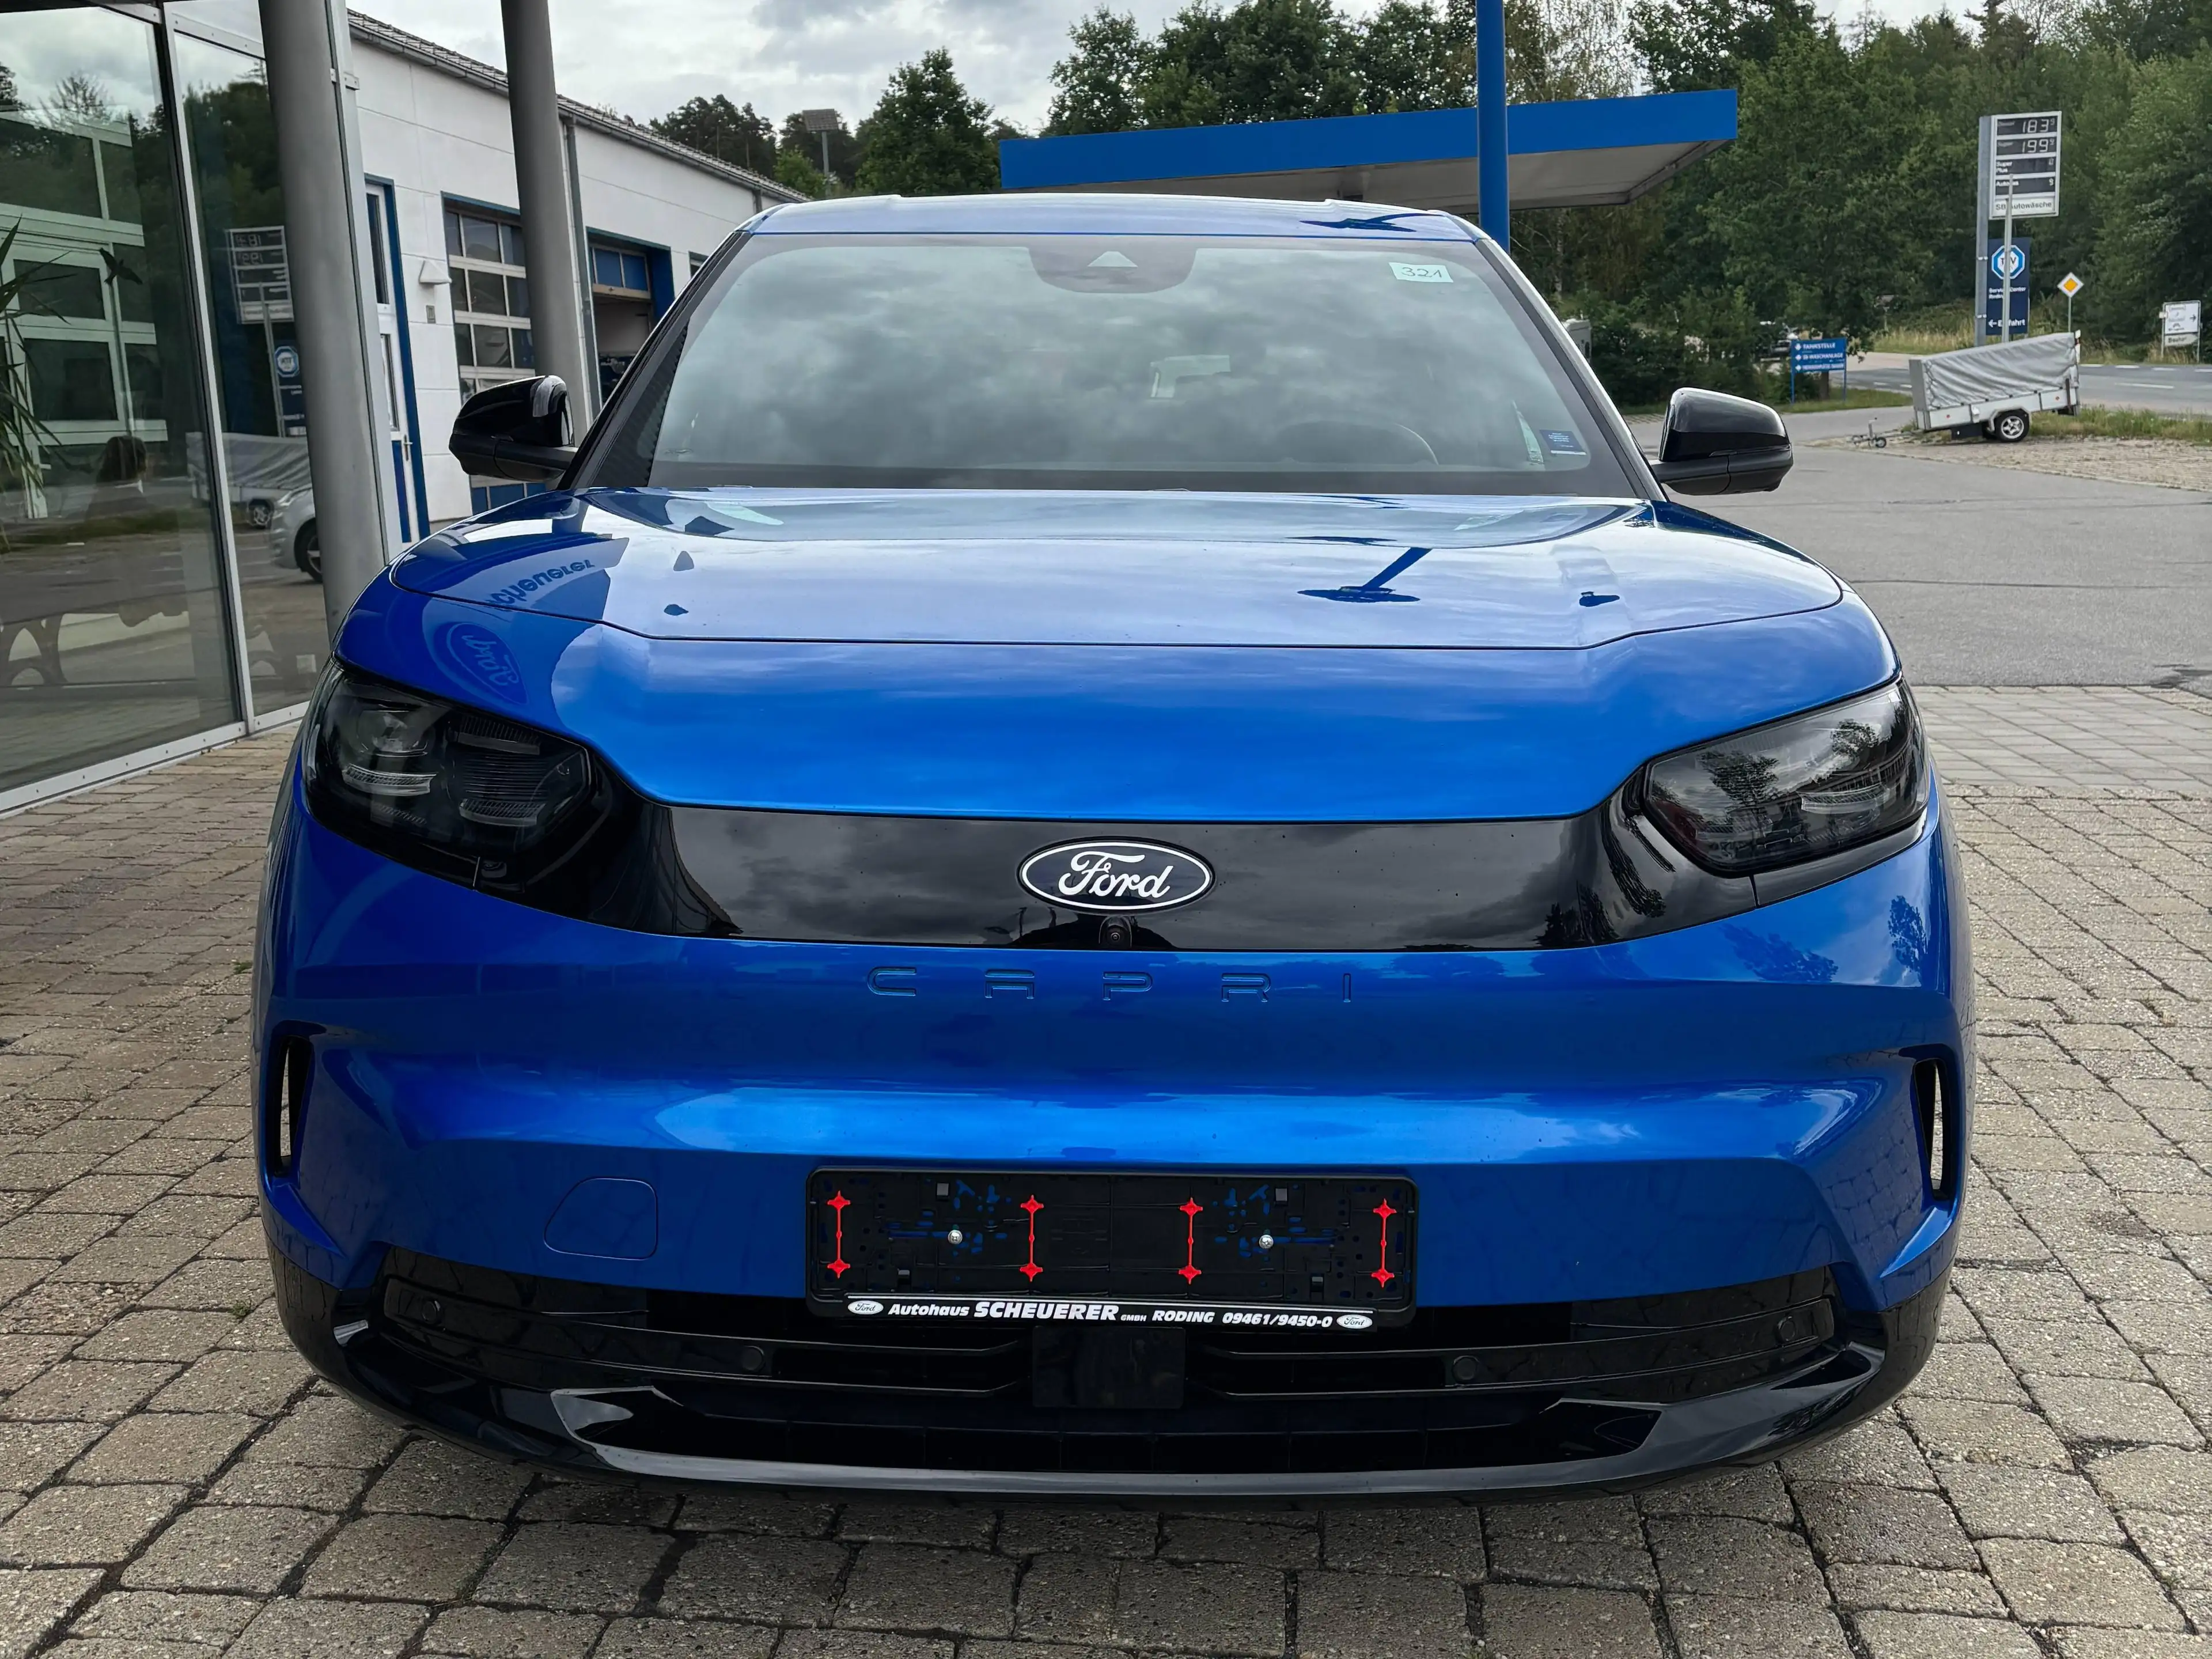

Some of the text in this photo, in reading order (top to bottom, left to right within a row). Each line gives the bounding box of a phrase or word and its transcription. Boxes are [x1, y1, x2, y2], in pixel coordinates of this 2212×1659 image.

[2022, 119, 2049, 133] 183
[2022, 139, 2048, 153] 199
[2011, 202, 2052, 210] utowäsche
[2001, 257, 2017, 265] TV
[1402, 267, 1442, 278] 321
[1058, 851, 1174, 899] Ford
[867, 966, 1351, 1002] CAPRI
[855, 1302, 876, 1313] Ford
[888, 1303, 969, 1317] Autohaus
[974, 1301, 1119, 1321] SCHEUERER
[1152, 1310, 1215, 1323] RODING
[1222, 1313, 1333, 1328] 09461/9450-0
[1343, 1316, 1365, 1327] Ford
